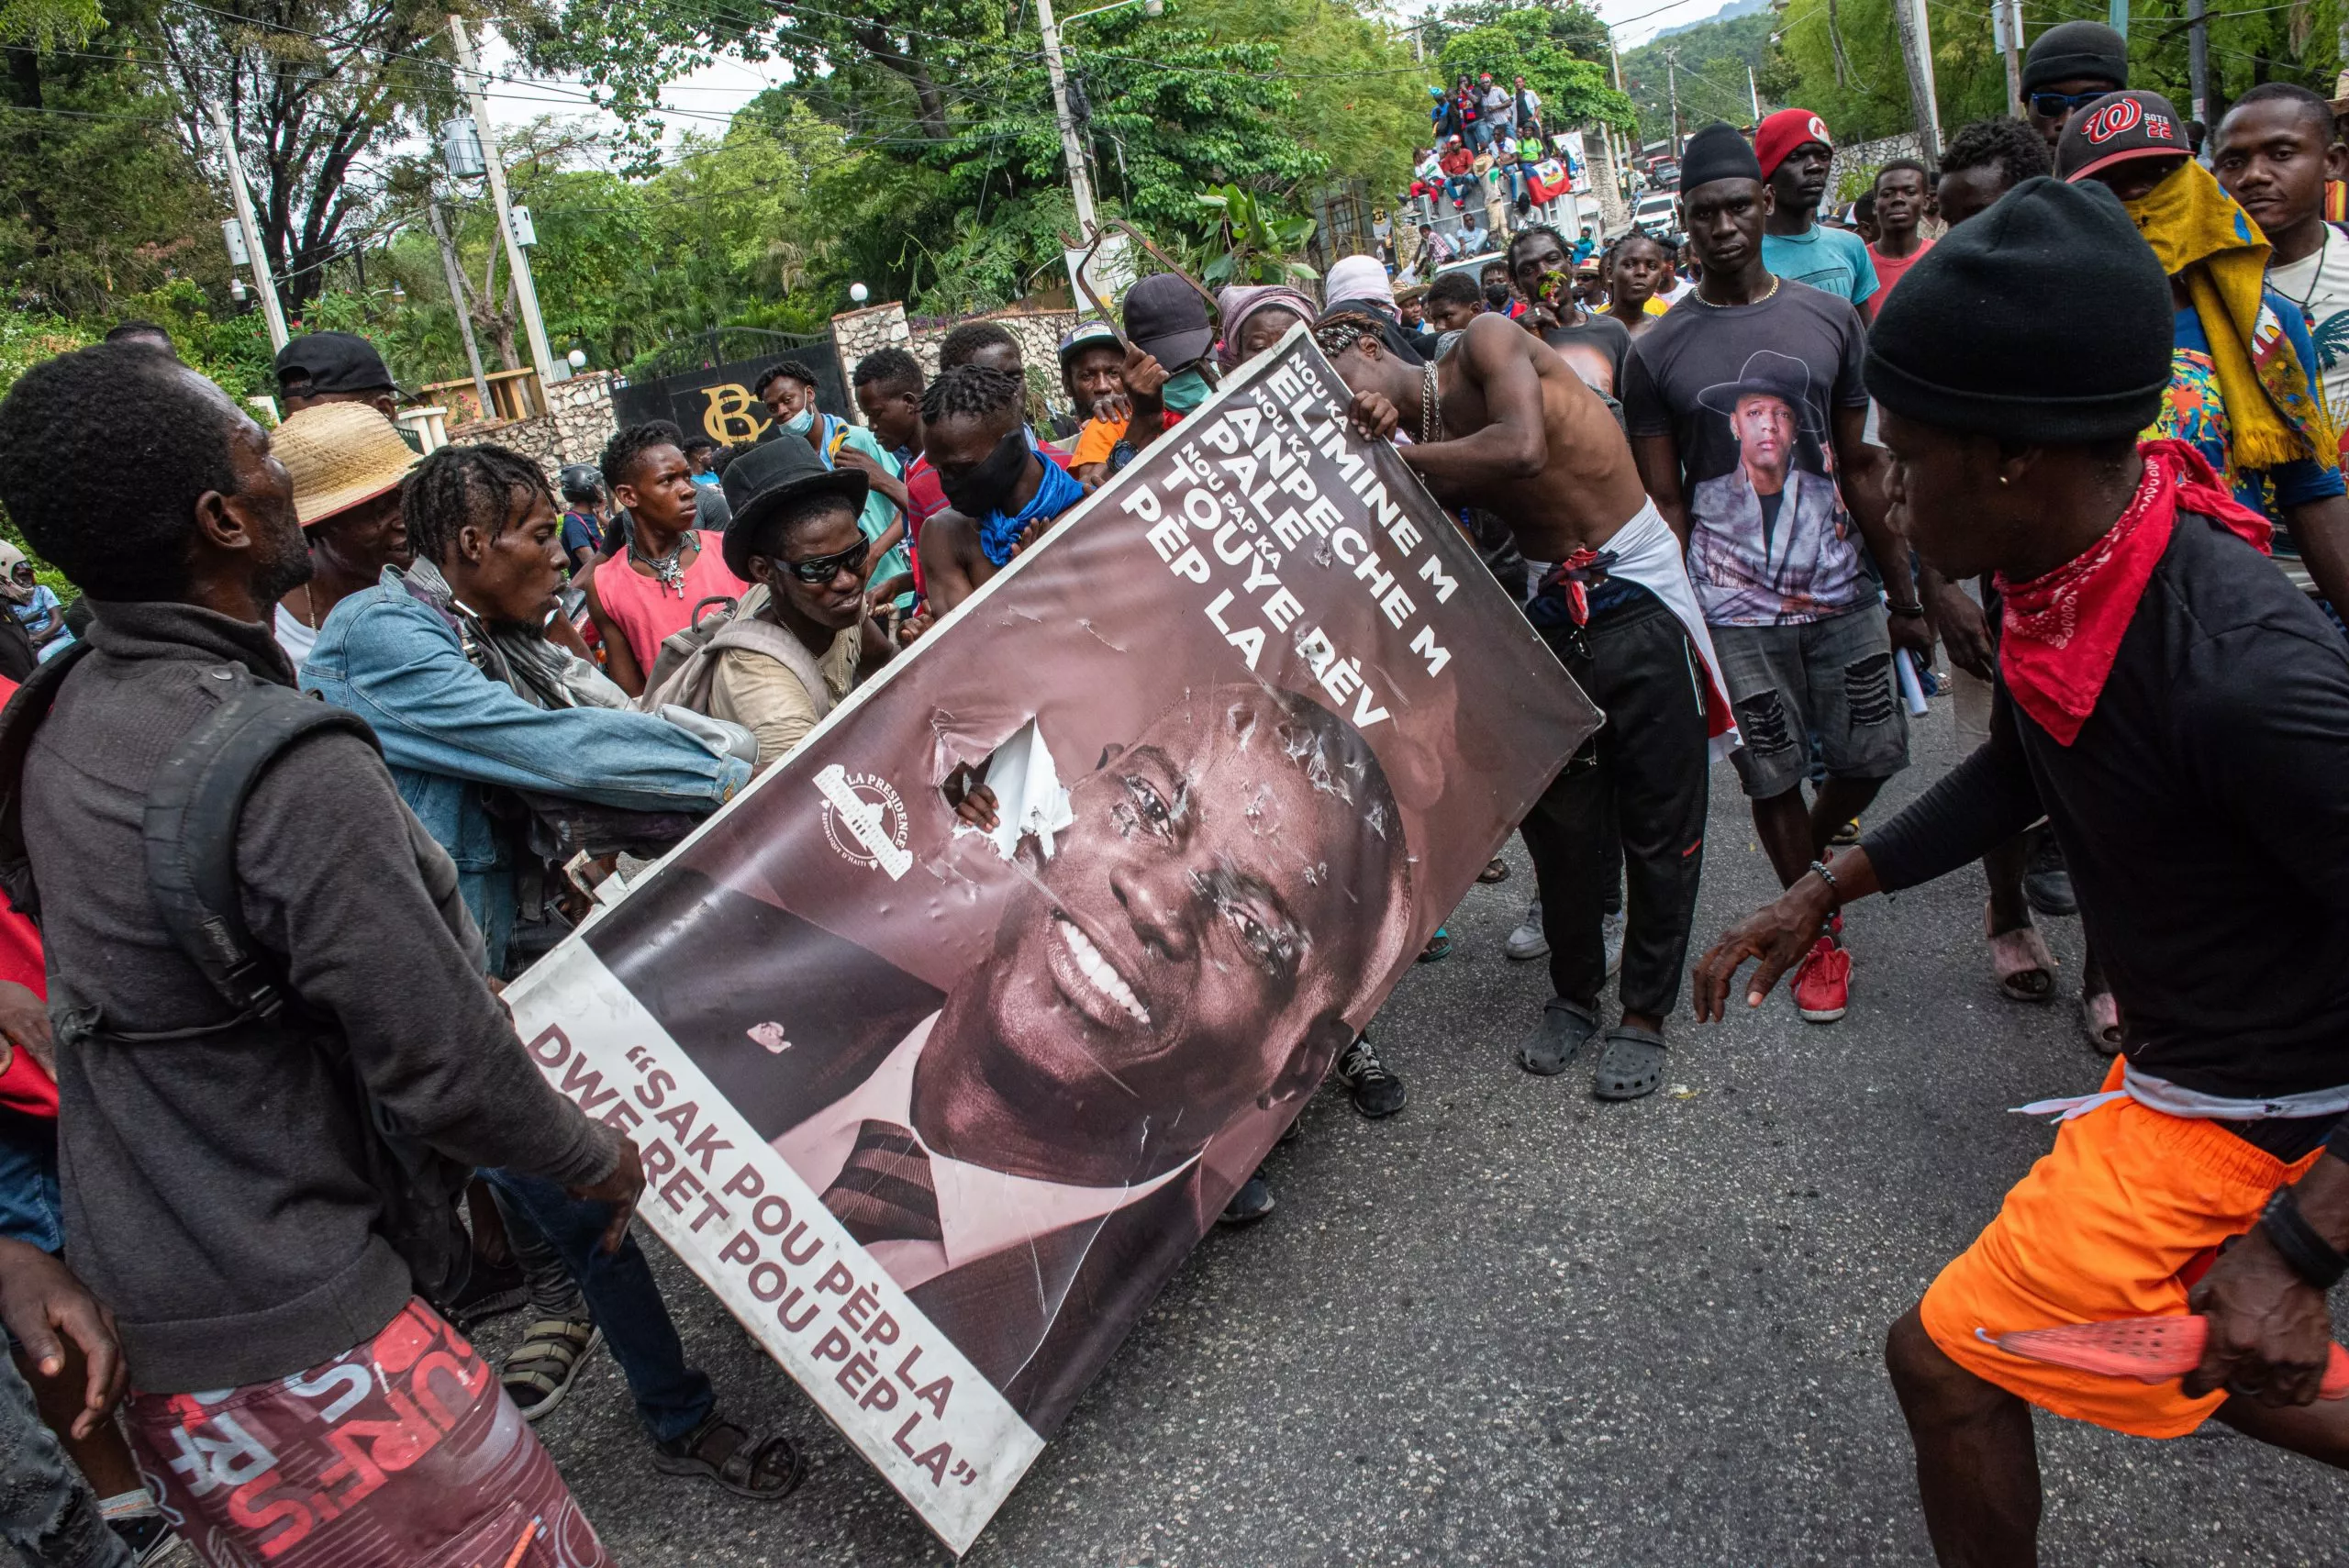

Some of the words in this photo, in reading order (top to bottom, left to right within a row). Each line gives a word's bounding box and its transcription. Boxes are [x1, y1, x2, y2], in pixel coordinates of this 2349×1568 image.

[2143, 113, 2168, 125] SOTO
[2145, 121, 2174, 140] 22
[1248, 385, 1289, 434] NOU
[1286, 432, 1312, 468] KA
[1287, 351, 1329, 399] NOU
[1324, 399, 1349, 432] KA
[1161, 451, 1306, 634] TOUYE
[1180, 440, 1226, 492] NOU
[1219, 491, 1258, 534] PAP
[1254, 534, 1282, 571] KA
[1199, 417, 1313, 552] PALE
[1223, 406, 1417, 630] ANPECHE
[1409, 624, 1453, 678] M
[1265, 363, 1423, 557] ELIMINE
[1418, 554, 1459, 605] M
[1119, 483, 1211, 584] PÈP
[1203, 587, 1267, 673] LA
[845, 772, 865, 786] LA
[866, 773, 908, 849] PRESIDENCE
[640, 1137, 730, 1234] RET
[718, 1228, 821, 1333] POU
[809, 1325, 898, 1412] PÈP
[720, 1162, 824, 1266] POU
[814, 1260, 901, 1346] PÈP
[895, 1343, 955, 1420] LA
